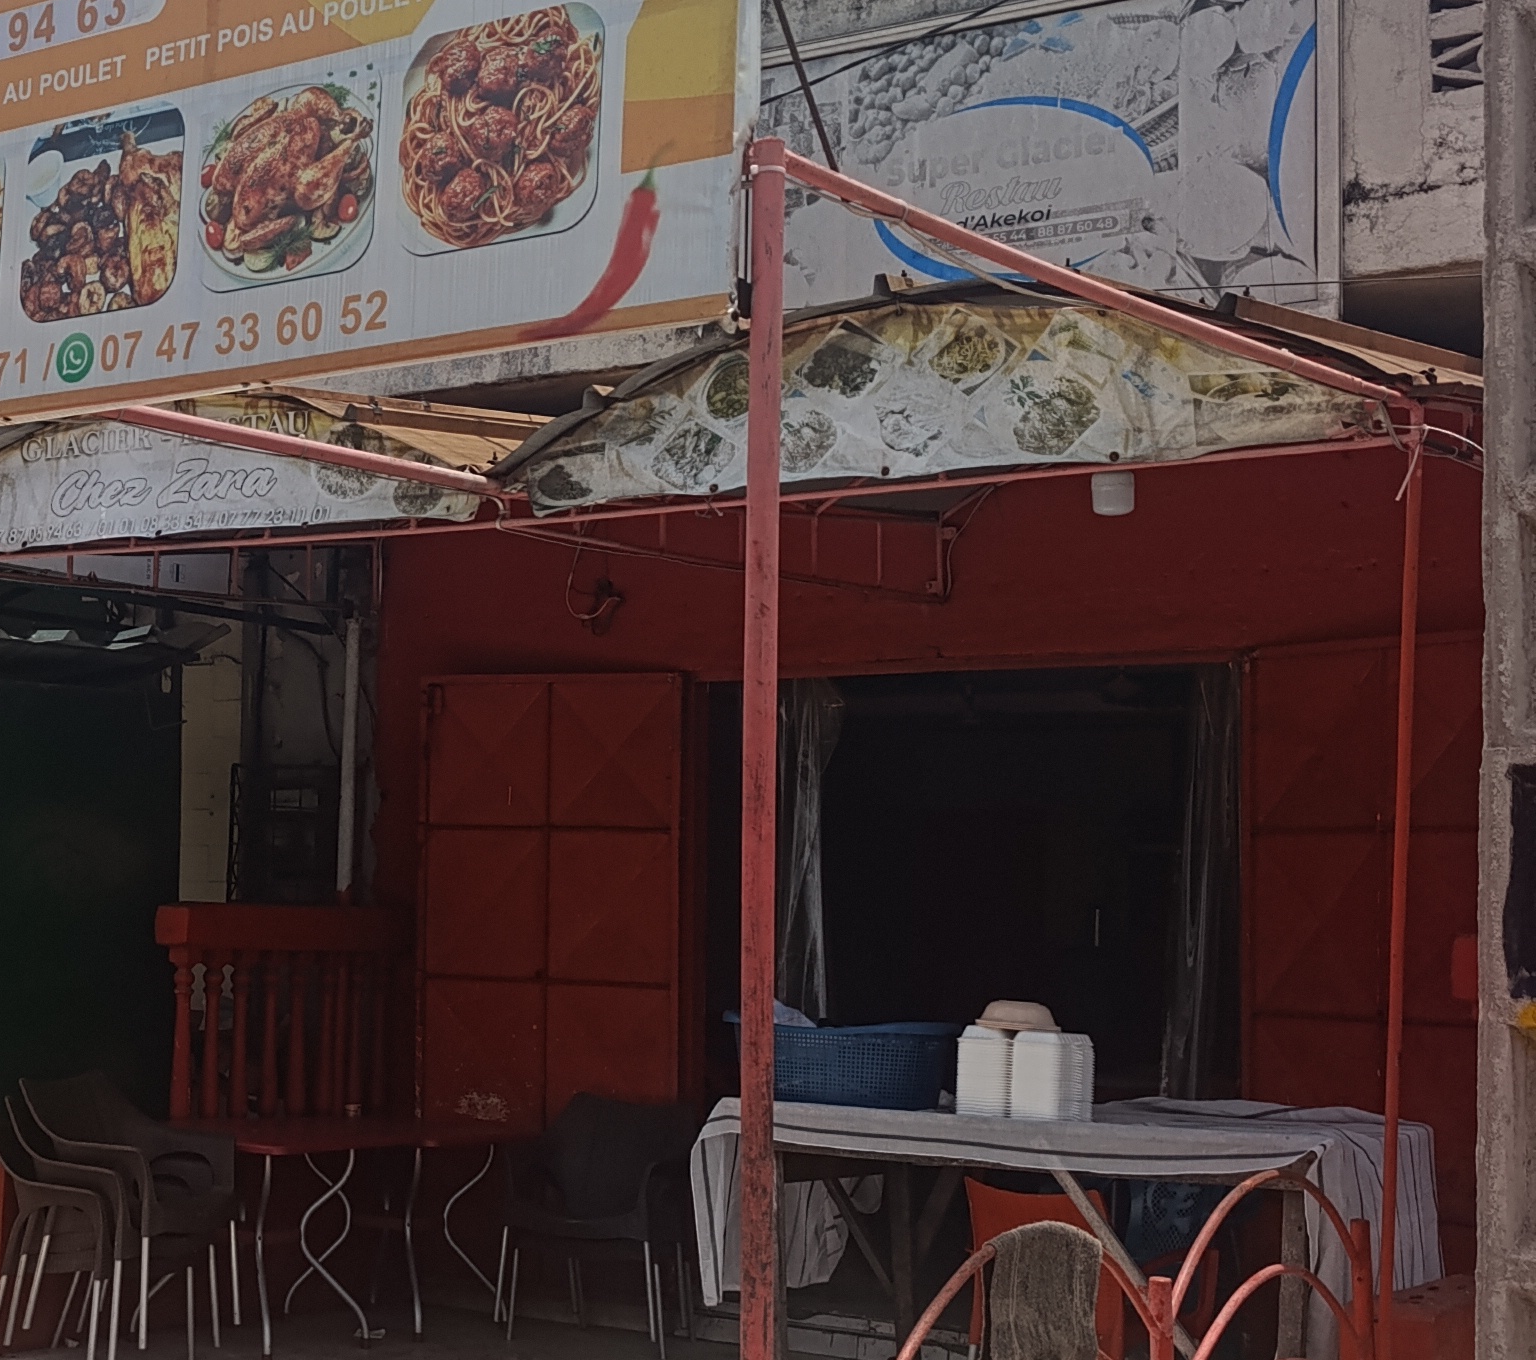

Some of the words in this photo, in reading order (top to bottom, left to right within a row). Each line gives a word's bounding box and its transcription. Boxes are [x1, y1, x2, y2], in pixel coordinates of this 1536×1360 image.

[8, 3, 56, 52] 94
[145, 33, 211, 70] PETIT
[217, 18, 273, 52] POIS
[279, 7, 315, 37] AU
[3, 78, 32, 105] AU
[39, 55, 127, 96] POULET
[886, 150, 986, 188] Super
[995, 131, 1116, 171] Glacier
[940, 175, 1063, 217] Restau
[955, 204, 1053, 232] d'Akekoi
[1010, 230, 1027, 241] 44
[1037, 227, 1054, 238] 88
[1057, 223, 1073, 234] 87
[1076, 220, 1092, 232] 60
[1096, 218, 1113, 229] 48
[100, 330, 143, 372] 07
[155, 321, 201, 363] 47
[214, 312, 260, 355] 33
[276, 301, 323, 346] 60
[339, 289, 388, 335] 52
[21, 427, 152, 463] GLACIER
[51, 469, 152, 518] Chez
[156, 458, 277, 509] Zara
[8, 528, 25, 543] 87
[28, 527, 43, 543] 05
[48, 525, 63, 539] 94
[66, 523, 83, 537] 63
[97, 520, 114, 535] 01
[119, 518, 135, 534] 01
[140, 517, 159, 532] 08
[184, 513, 203, 529] 54
[218, 512, 237, 526] 07
[242, 510, 262, 524] 77
[265, 509, 286, 524] 23
[290, 508, 306, 523] 11
[313, 506, 331, 522] 01
